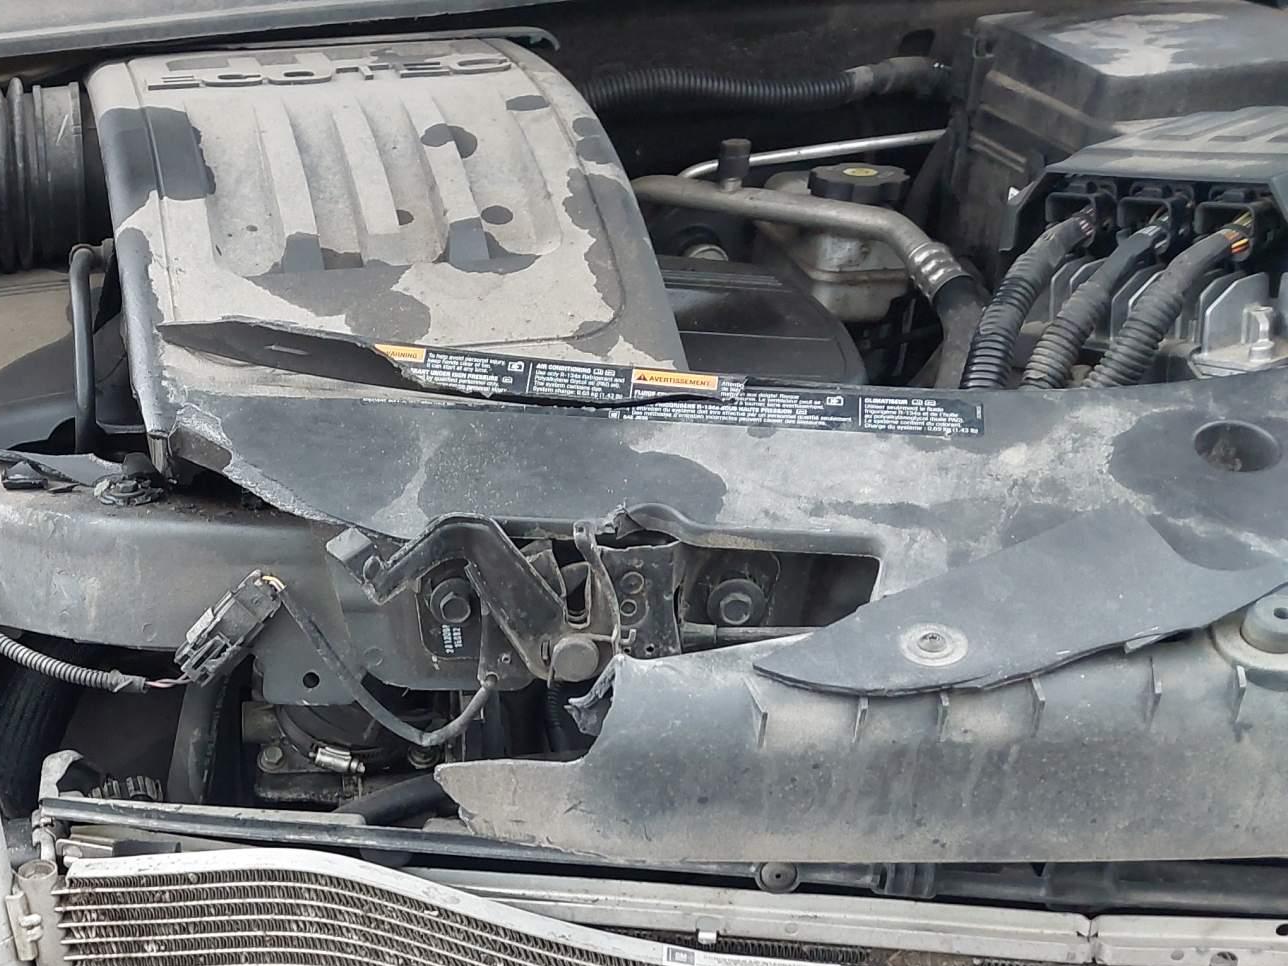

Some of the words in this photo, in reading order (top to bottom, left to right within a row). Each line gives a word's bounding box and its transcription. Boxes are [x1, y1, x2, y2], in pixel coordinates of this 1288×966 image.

[147, 56, 513, 91] ECOTEC
[465, 356, 489, 364] personal
[536, 362, 548, 370] AIR
[548, 364, 592, 374] CONDITIONING
[467, 373, 498, 381] PRESSURE
[648, 375, 711, 387] AVERTISSEMENT
